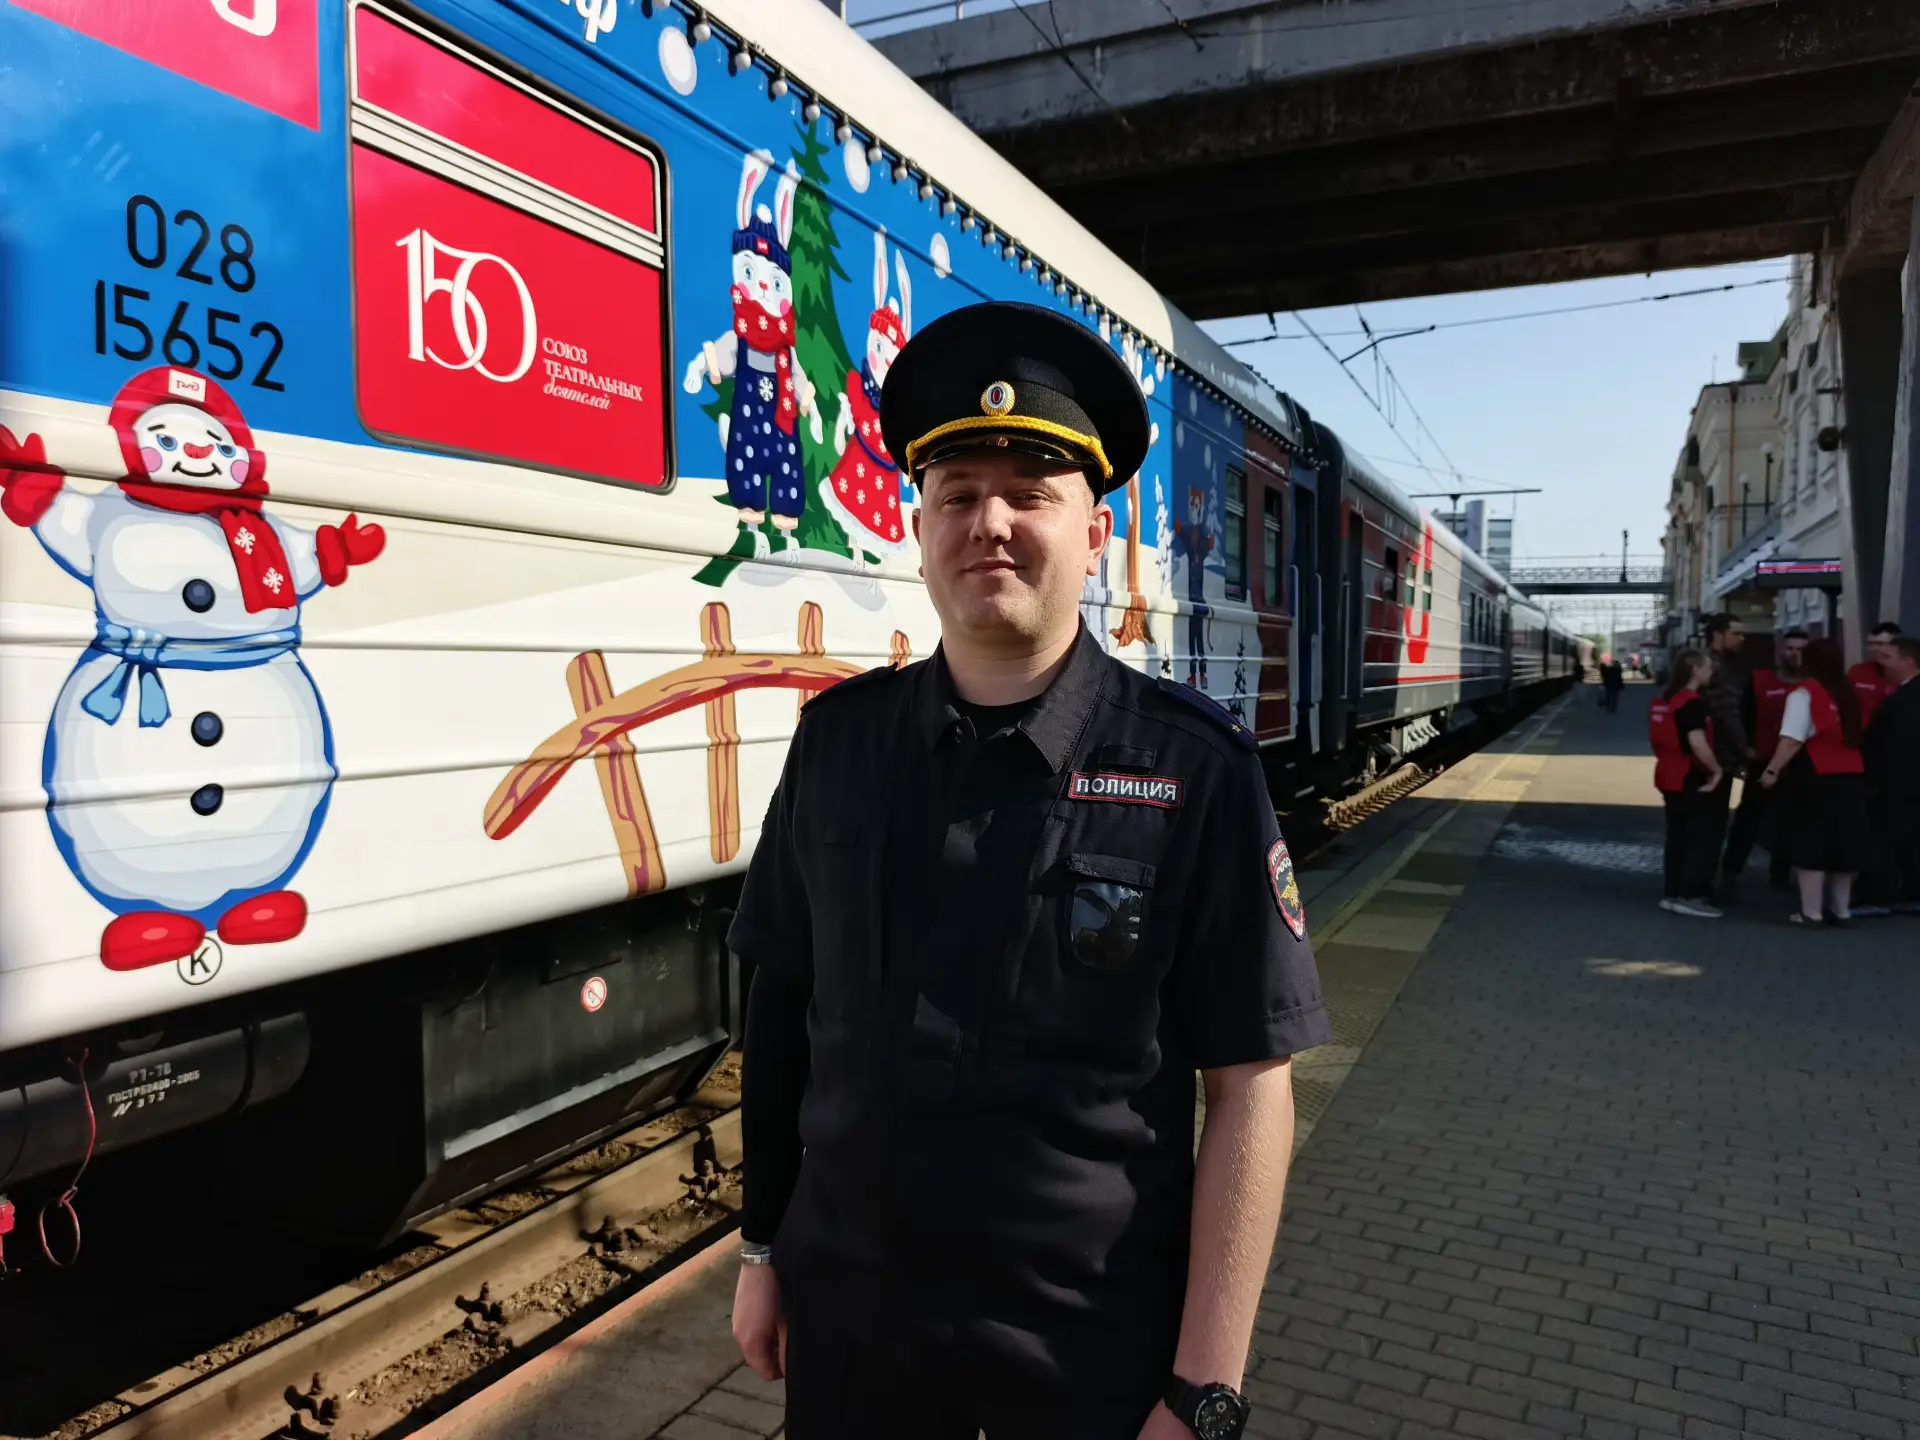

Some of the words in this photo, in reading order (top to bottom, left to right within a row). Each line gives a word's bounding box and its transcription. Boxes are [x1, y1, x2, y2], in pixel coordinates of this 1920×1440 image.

[127, 195, 256, 293] 028
[95, 279, 285, 392] 15652
[396, 228, 538, 383] 150
[542, 337, 588, 365] СОЮЗ
[543, 358, 643, 402] ТЕАТРАЛЬНЫХ
[1076, 778, 1177, 801] ПОЛИЦИЯ
